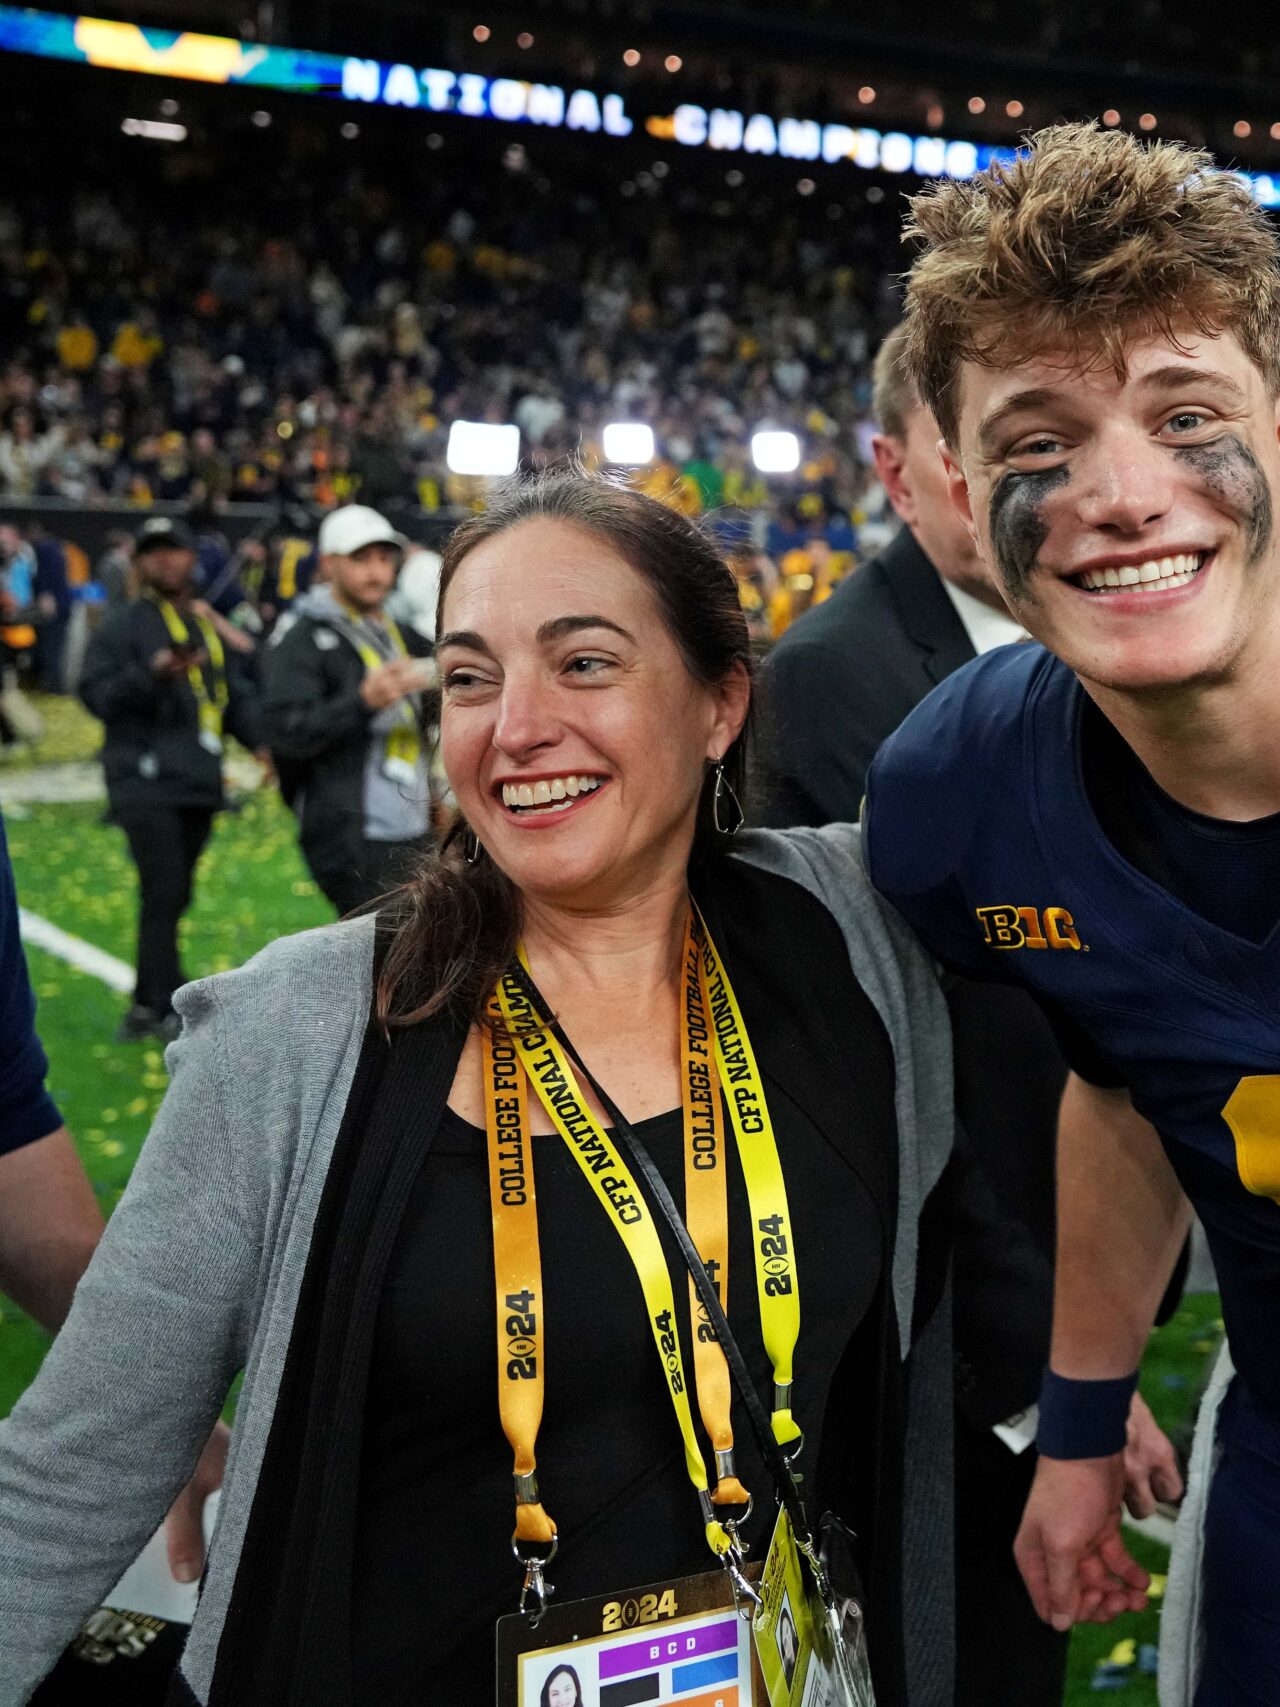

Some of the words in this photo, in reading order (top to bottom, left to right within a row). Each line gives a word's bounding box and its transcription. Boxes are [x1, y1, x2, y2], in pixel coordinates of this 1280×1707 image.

[341, 56, 633, 137] NATIONAL
[686, 947, 710, 1058] FOOTBALL
[709, 971, 753, 1084] NATIONAL
[495, 1096, 527, 1206] COLLEGE
[533, 1049, 617, 1174] NATIONAL
[690, 1060, 717, 1171] COLLEGE
[732, 1087, 764, 1134] CFP
[600, 1176, 643, 1225] CFP
